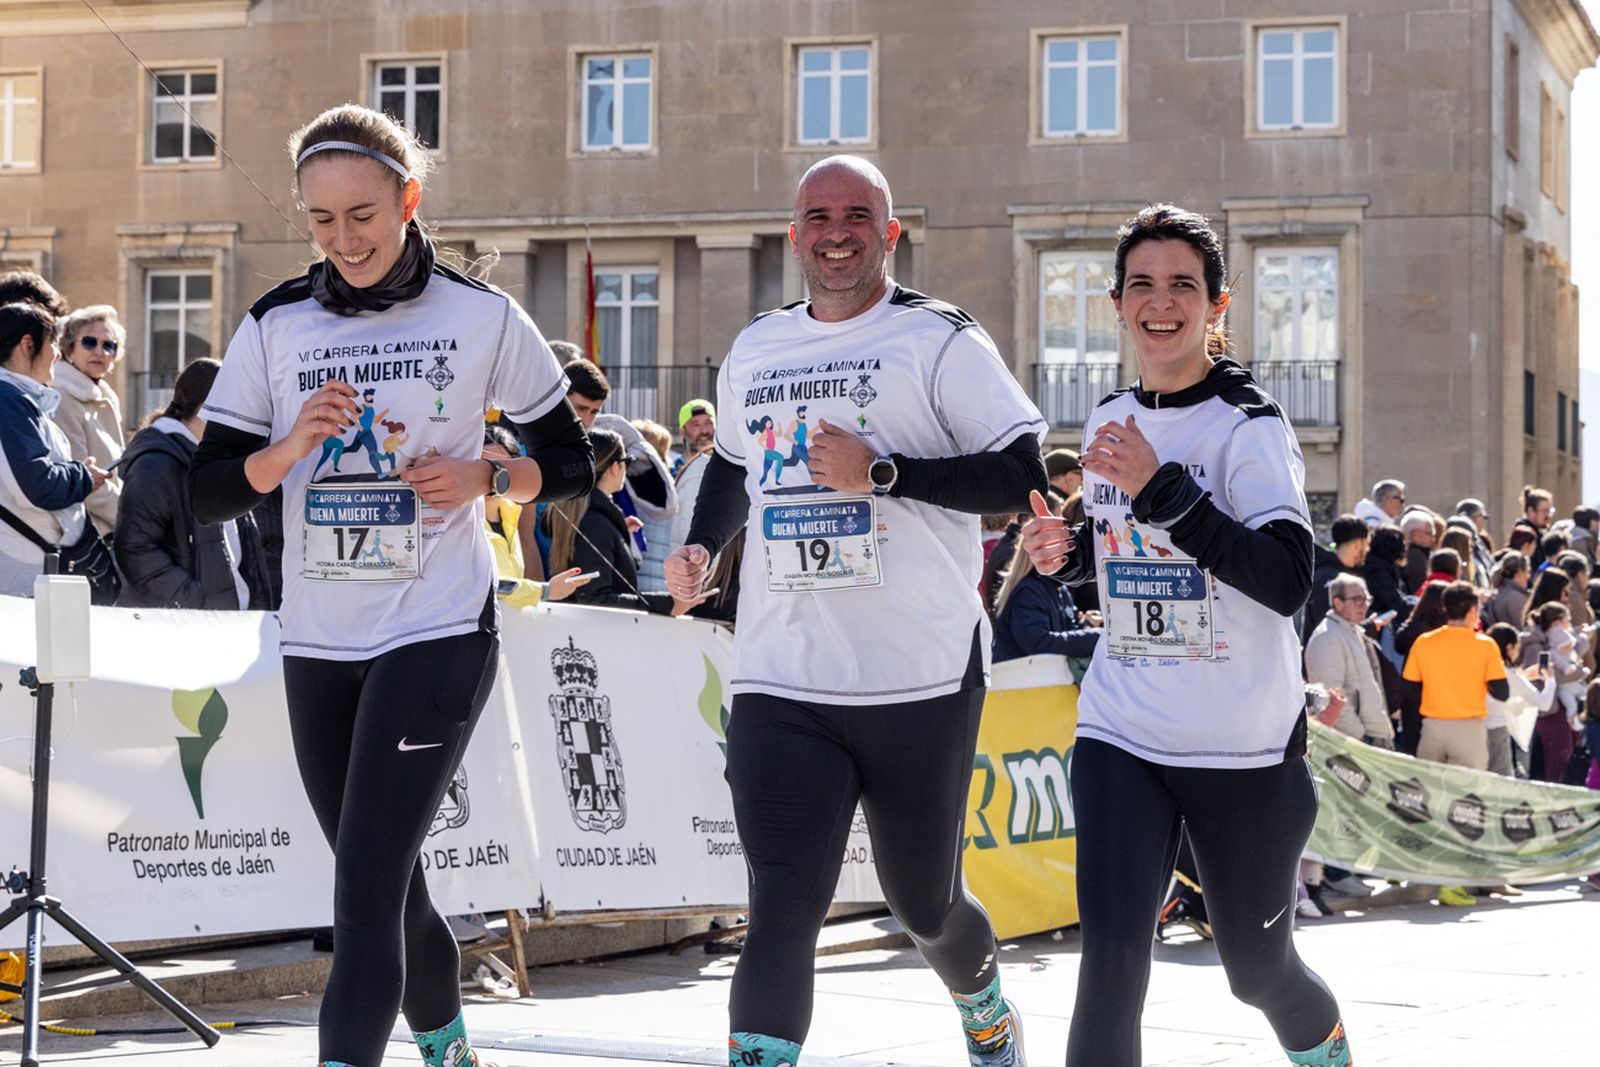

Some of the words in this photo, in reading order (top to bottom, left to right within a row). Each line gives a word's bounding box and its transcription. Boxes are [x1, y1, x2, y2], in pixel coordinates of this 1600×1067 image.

[298, 351, 310, 363] VI
[313, 344, 379, 360] CARRERA
[384, 339, 458, 354] CAMINATA
[298, 366, 348, 392] BUENA
[354, 359, 424, 384] MUERTE
[752, 371, 761, 383] VI
[762, 366, 814, 381] CARRERA
[817, 359, 881, 373] CAMINATA
[745, 384, 785, 408] BUENA
[790, 378, 848, 401] MUERTE
[314, 494, 352, 503] CARRERA
[354, 493, 401, 503] CAMINATA
[338, 507, 380, 521] MUERTE
[780, 509, 811, 518] CARRERA
[813, 506, 858, 516] CAMINATA
[772, 523, 798, 536] BUENA
[799, 520, 838, 535] MUERTE
[333, 527, 370, 561] 17
[795, 539, 830, 571] 19
[1122, 566, 1148, 576] CARRERA
[1150, 567, 1191, 577] CAMINATA
[1137, 581, 1173, 596] MUERTE
[1133, 601, 1165, 636] 18
[692, 816, 735, 834] Patronato
[107, 832, 189, 852] Patronato
[194, 828, 267, 853] Municipal
[271, 827, 291, 847] de
[707, 838, 742, 859] Deporte
[434, 848, 461, 869] DE
[465, 839, 509, 867] JAÉN
[556, 847, 606, 867] CIUDAD
[626, 842, 656, 866] JAÉN
[132, 857, 207, 883] Deportes
[211, 856, 232, 876] de
[236, 853, 275, 876] Jaén
